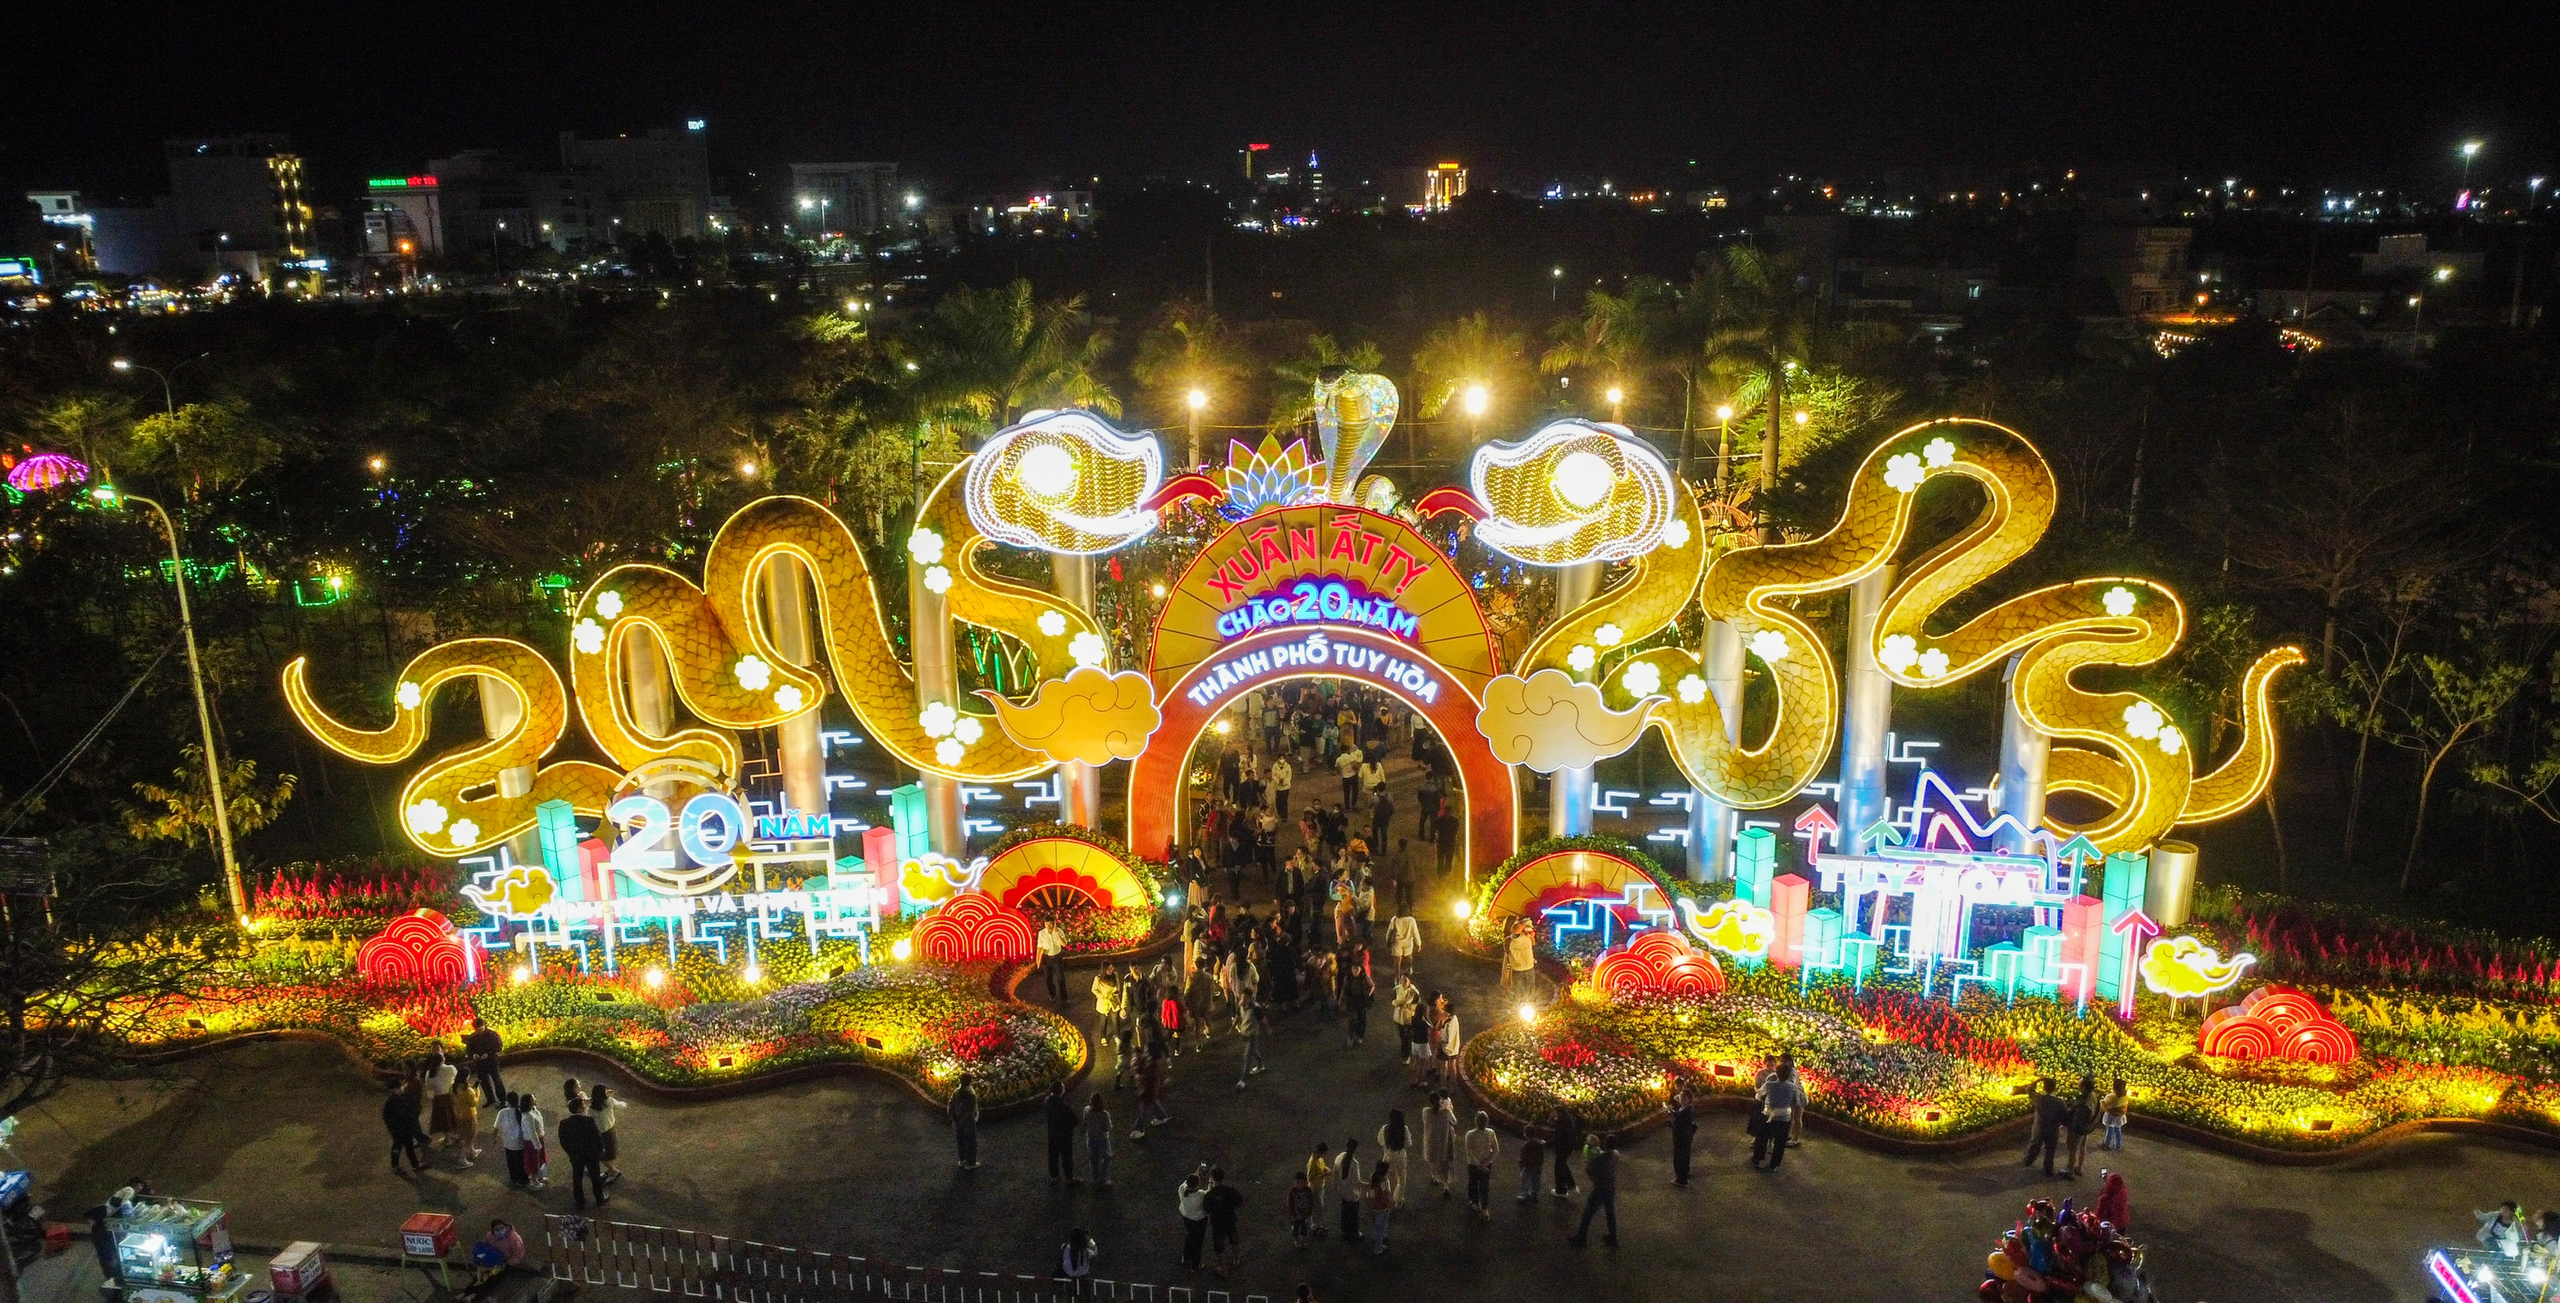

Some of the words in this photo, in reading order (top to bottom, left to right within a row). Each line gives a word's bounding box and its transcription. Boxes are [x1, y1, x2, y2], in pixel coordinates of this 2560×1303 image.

[1207, 526, 1317, 604] XUÂN
[1329, 514, 1384, 566] ẤT
[1381, 544, 1429, 595] TỴ
[1217, 598, 1291, 637] CHÀO
[1292, 582, 1350, 620] 20
[1351, 597, 1418, 638] NĂM
[1187, 653, 1270, 707] THÀNH
[1272, 632, 1329, 668] PHỐ
[1332, 644, 1386, 673] TUY
[1383, 659, 1440, 704] HÒA
[606, 792, 747, 869] 20
[760, 808, 832, 839] NĂM
[1815, 857, 1917, 897] TUY
